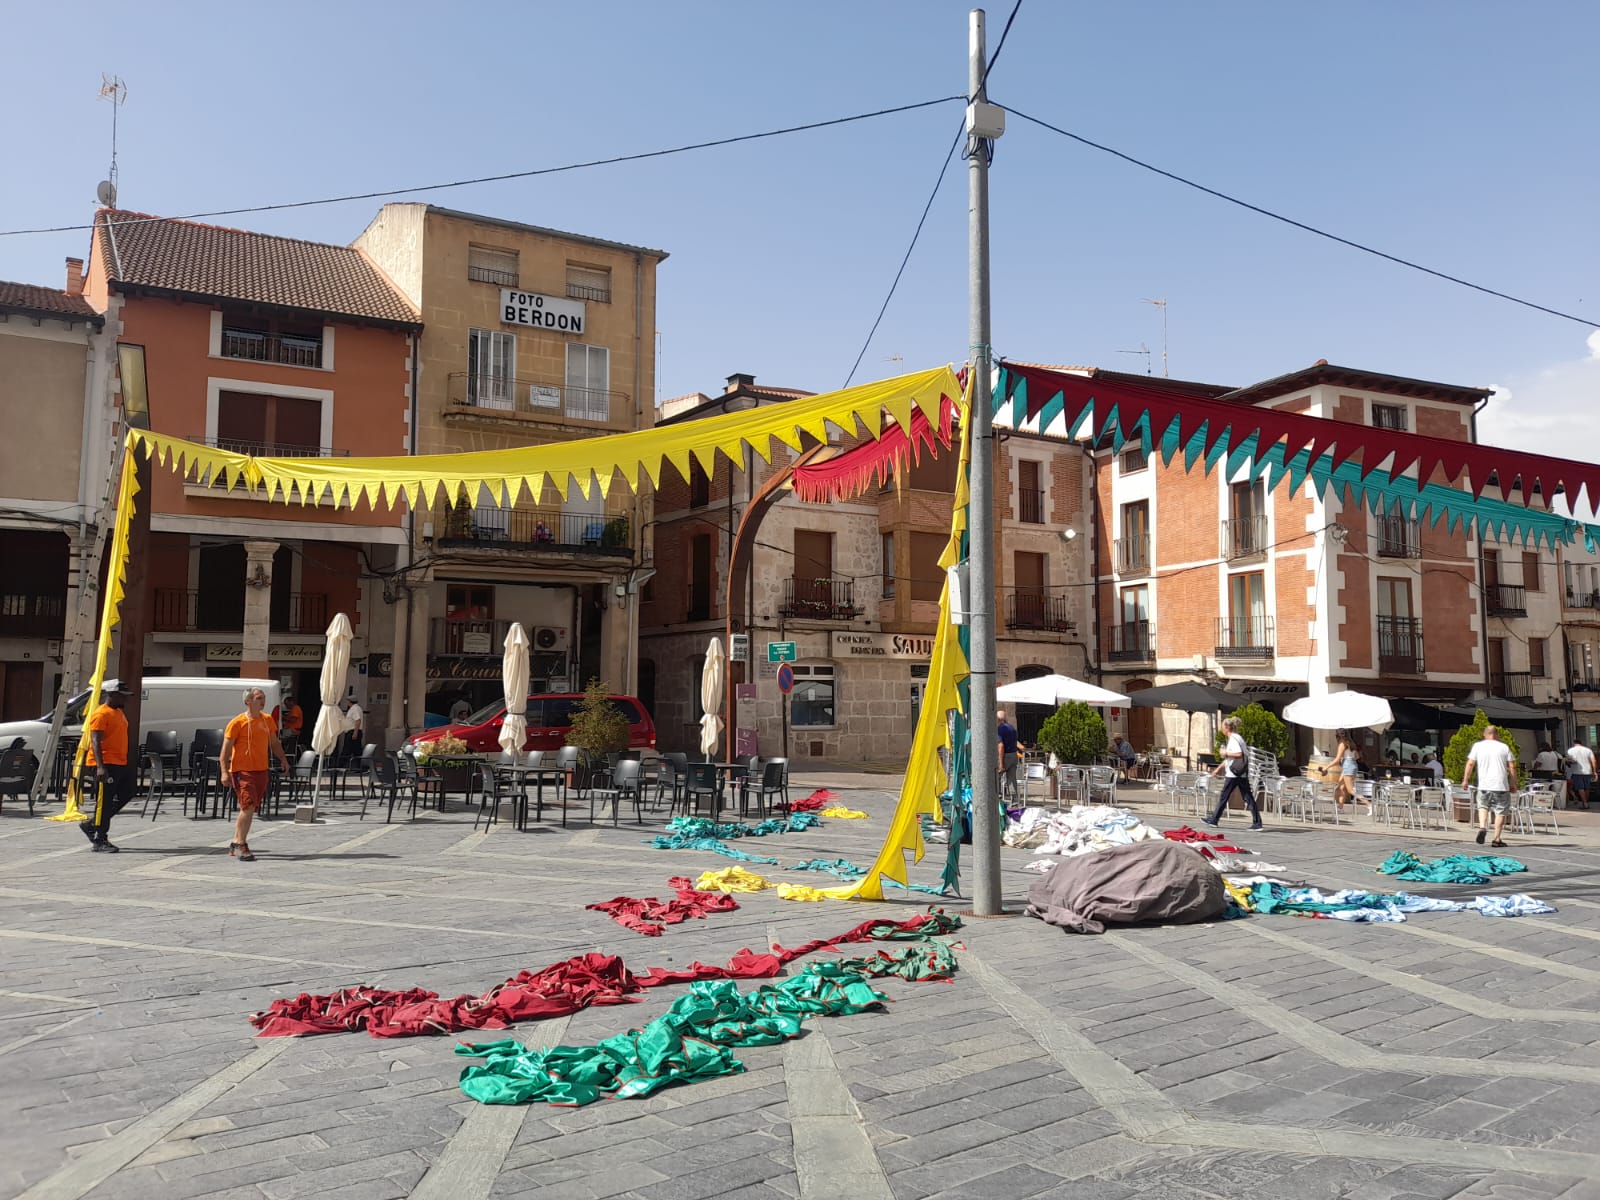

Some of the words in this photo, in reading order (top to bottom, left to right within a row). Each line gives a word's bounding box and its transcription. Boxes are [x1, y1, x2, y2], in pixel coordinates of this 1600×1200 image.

[510, 291, 544, 309] FOTO
[505, 306, 581, 331] BERDON
[284, 645, 319, 657] Ribera
[1241, 685, 1298, 694] BACALAO
